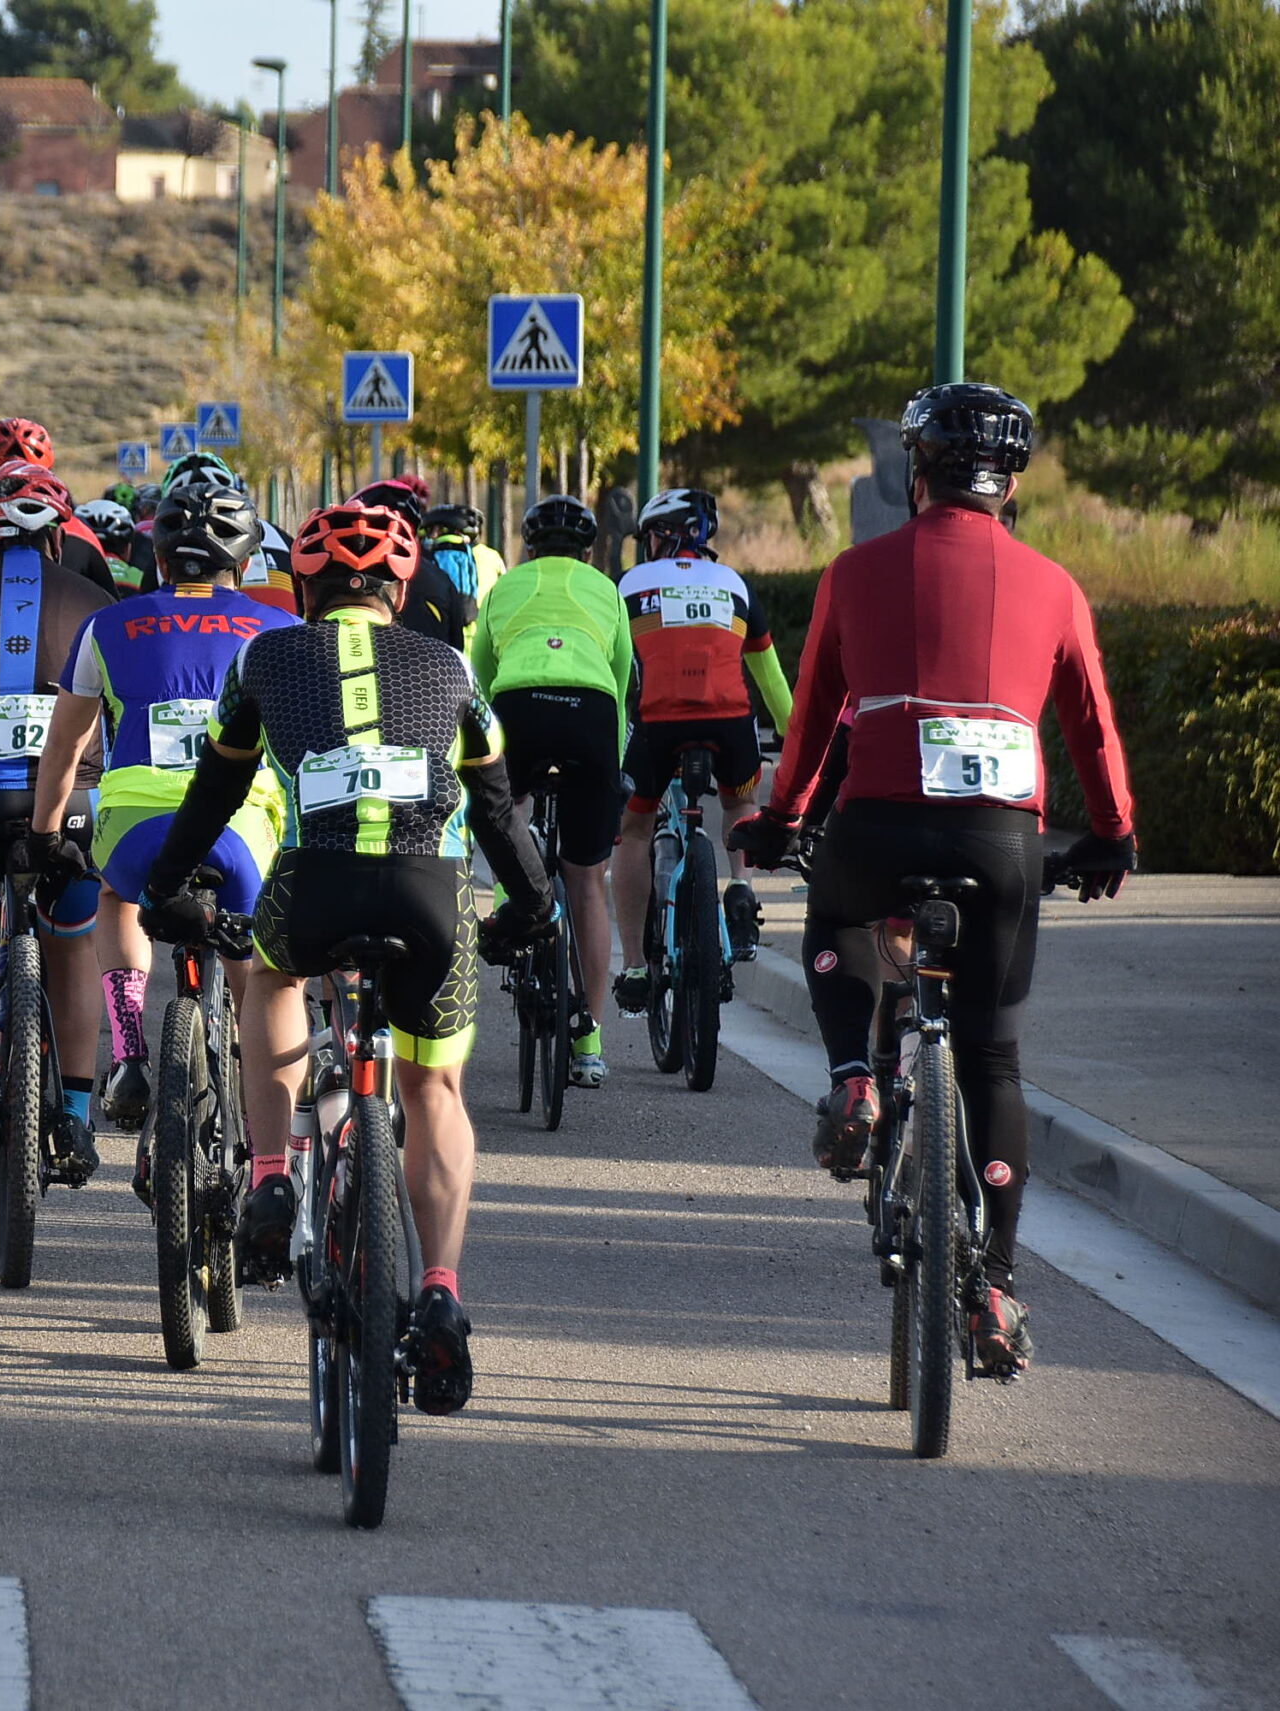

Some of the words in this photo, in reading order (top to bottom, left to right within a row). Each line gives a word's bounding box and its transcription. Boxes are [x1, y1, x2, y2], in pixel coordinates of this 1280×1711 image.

[4, 576, 39, 586] sky
[686, 603, 711, 619] 60
[351, 687, 369, 711] EJEA
[162, 709, 208, 717] TWIN
[11, 723, 45, 750] 82
[342, 767, 382, 794] 70
[962, 754, 999, 787] 53
